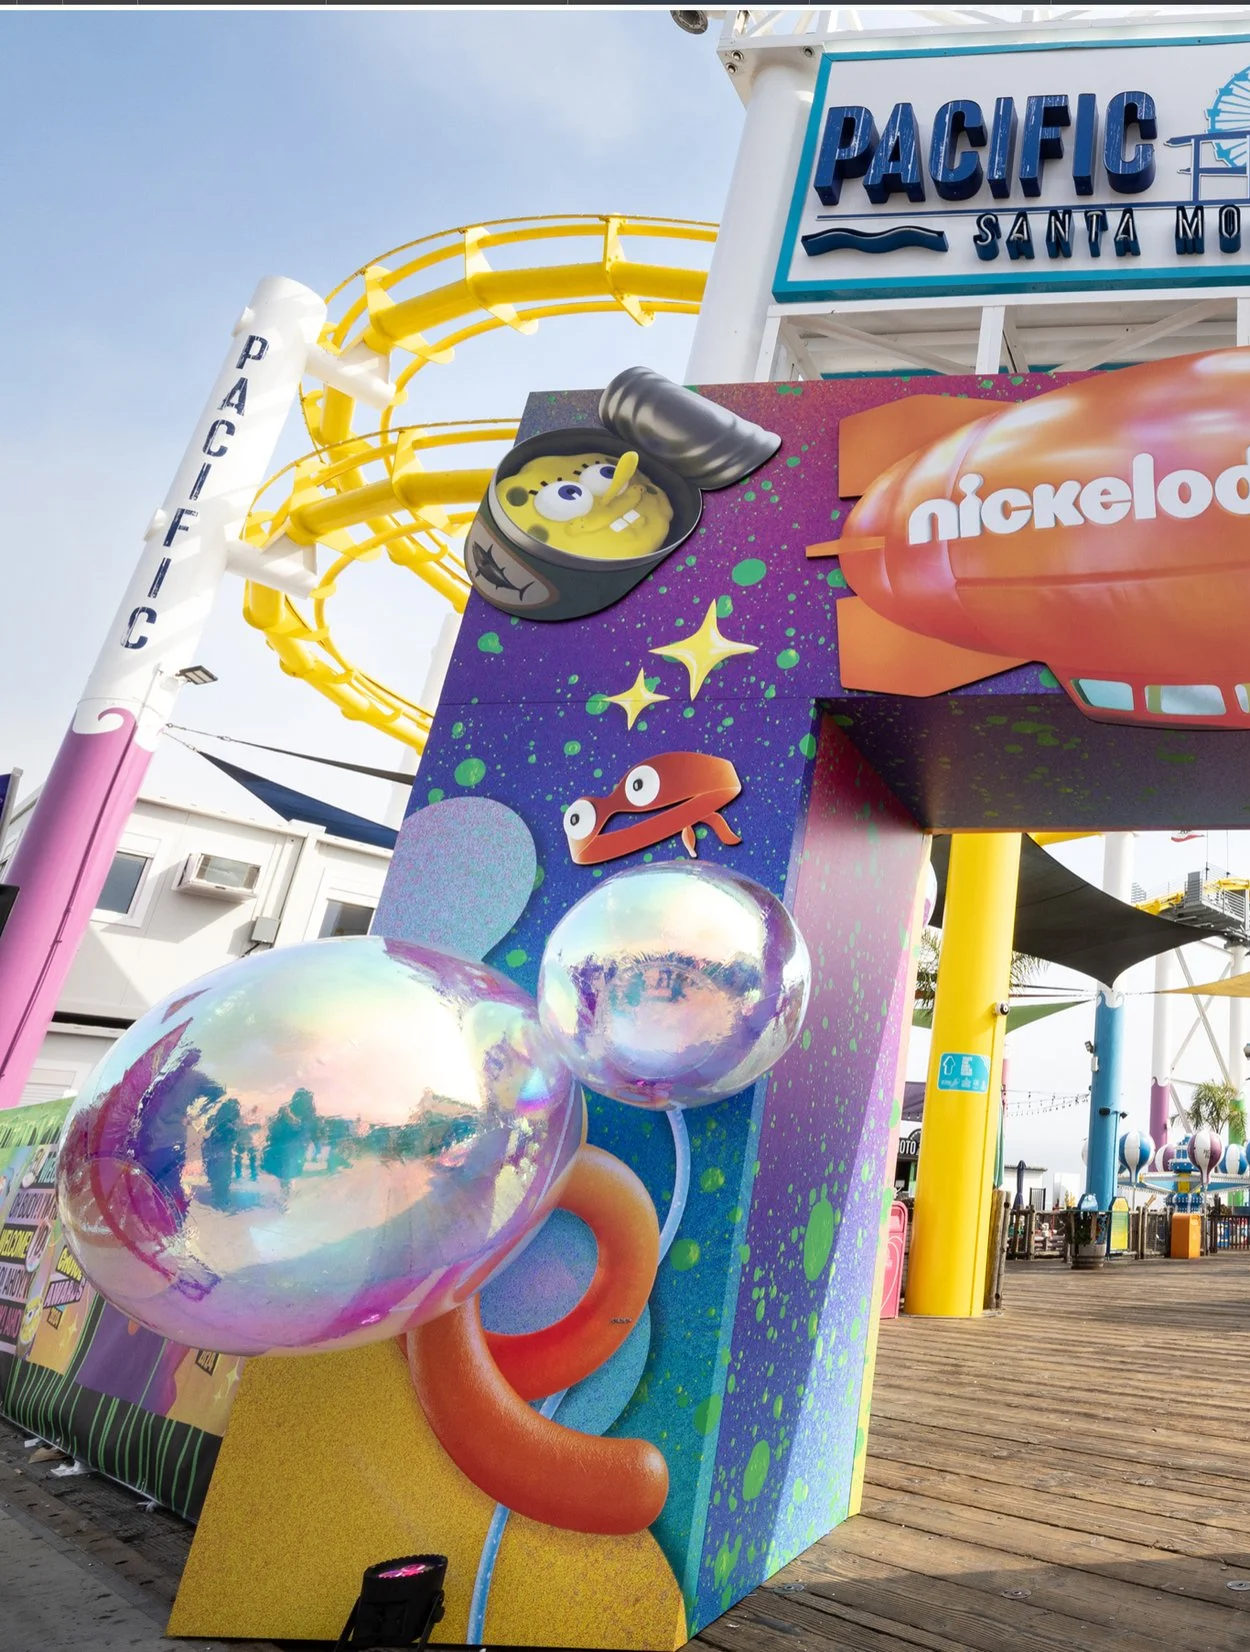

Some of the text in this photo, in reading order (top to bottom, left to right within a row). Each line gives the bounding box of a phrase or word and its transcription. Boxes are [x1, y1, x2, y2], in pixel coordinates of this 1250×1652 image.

[813, 90, 1158, 206] PACIFIC
[972, 207, 1142, 261] SANTA
[120, 334, 270, 650] PACIFIC
[900, 1140, 917, 1155] OTO
